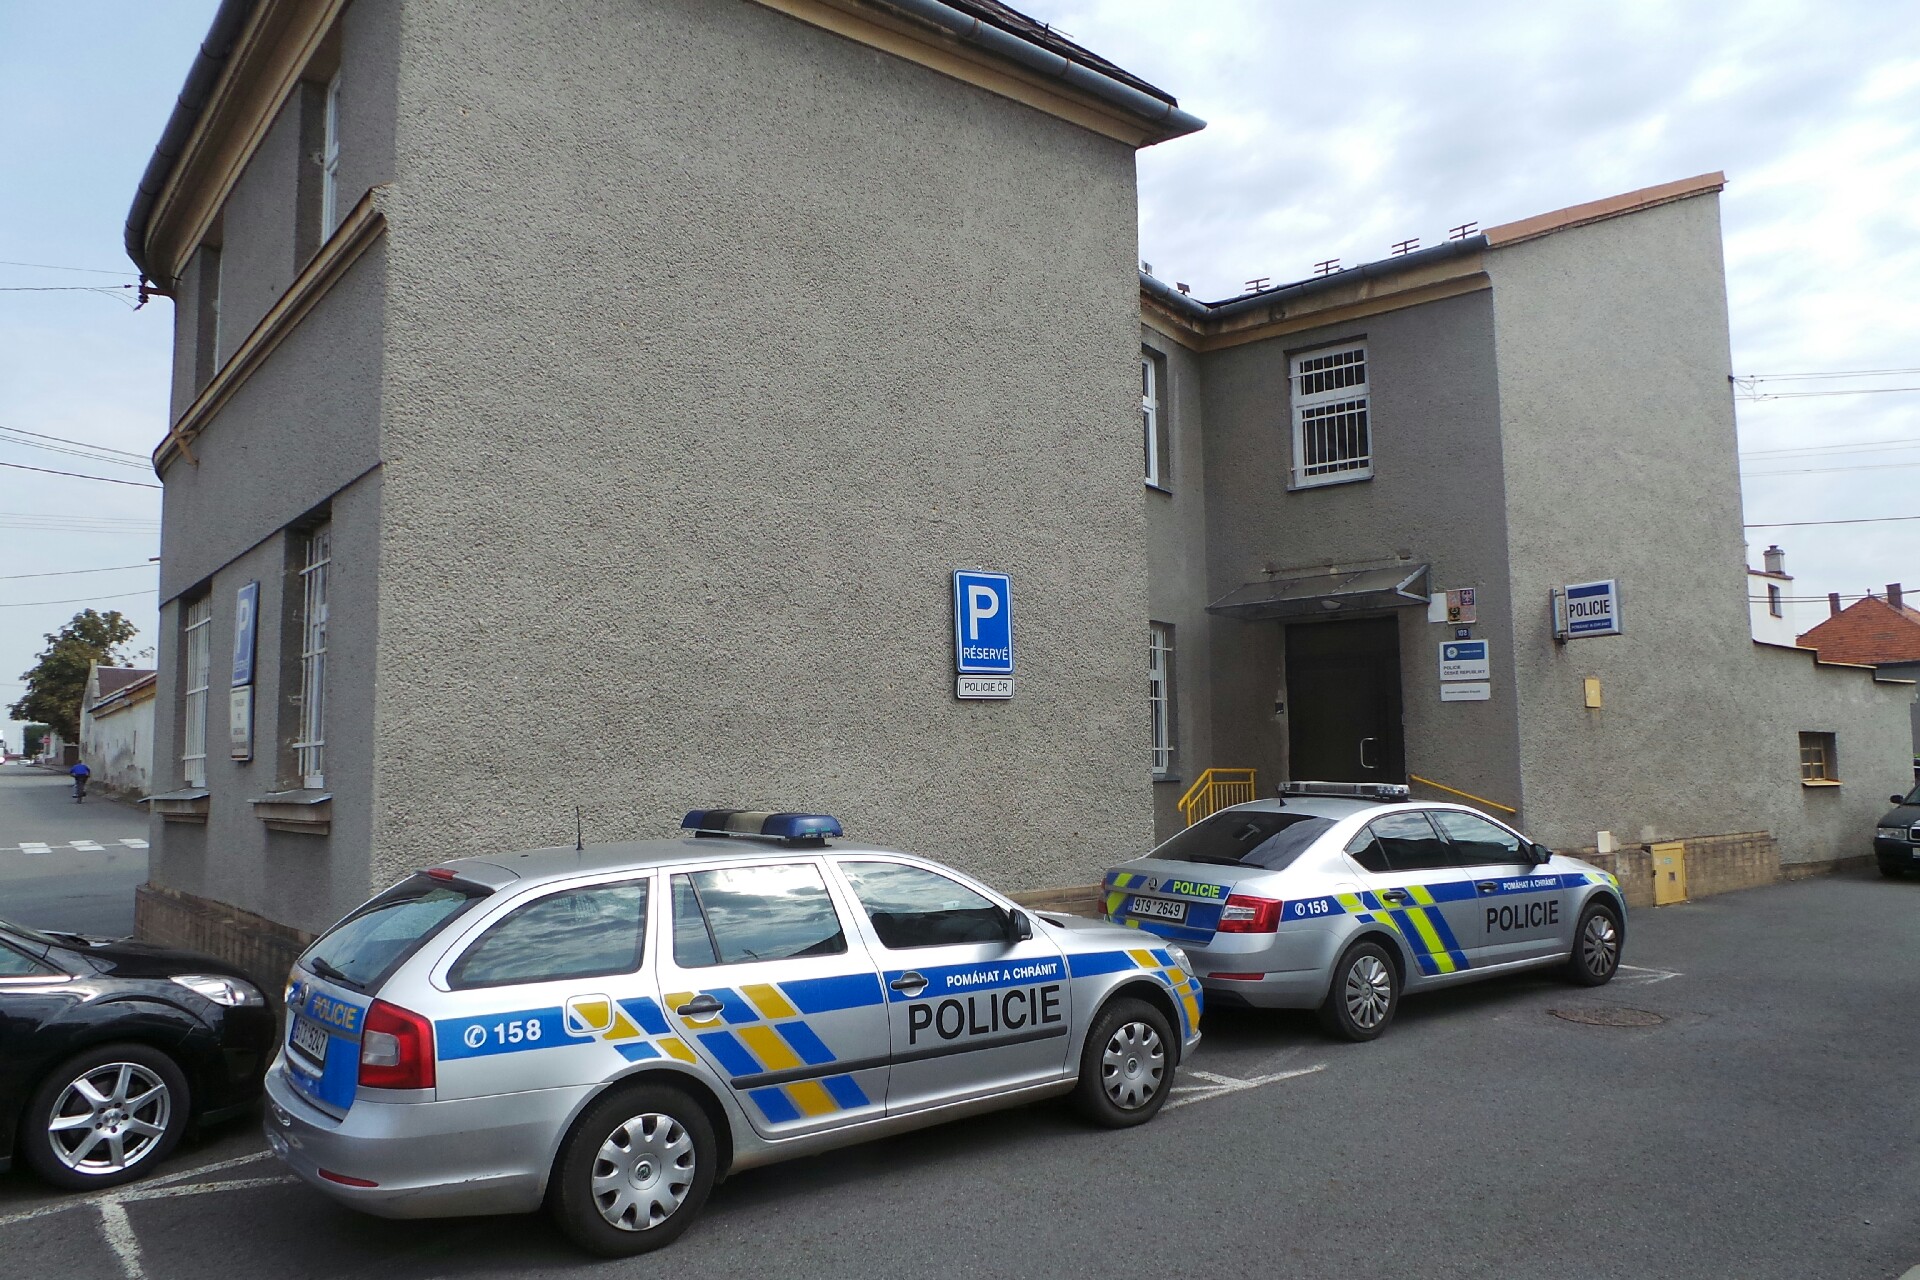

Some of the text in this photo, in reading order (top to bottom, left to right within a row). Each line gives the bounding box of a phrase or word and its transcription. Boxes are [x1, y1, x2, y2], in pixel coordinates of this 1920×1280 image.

[968, 585, 999, 640] P
[1569, 600, 1611, 618] POLICIE
[963, 645, 1009, 660] RÉSERVÉ
[964, 682, 1008, 692] POLICIE ČR
[1172, 880, 1221, 898] POLICIE
[1502, 880, 1529, 890] POMÁHAT
[1535, 878, 1557, 887] CHRÁNIT
[1134, 898, 1151, 912] 9T9
[1156, 902, 1181, 916] 2649
[1307, 900, 1329, 914] 158
[1486, 900, 1559, 933] POLICIE
[946, 963, 1058, 987] POMÁHAT A CHRÁNIT
[313, 996, 358, 1029] POLICIE
[908, 984, 1062, 1045] POLICIE
[493, 1019, 542, 1044] 158
